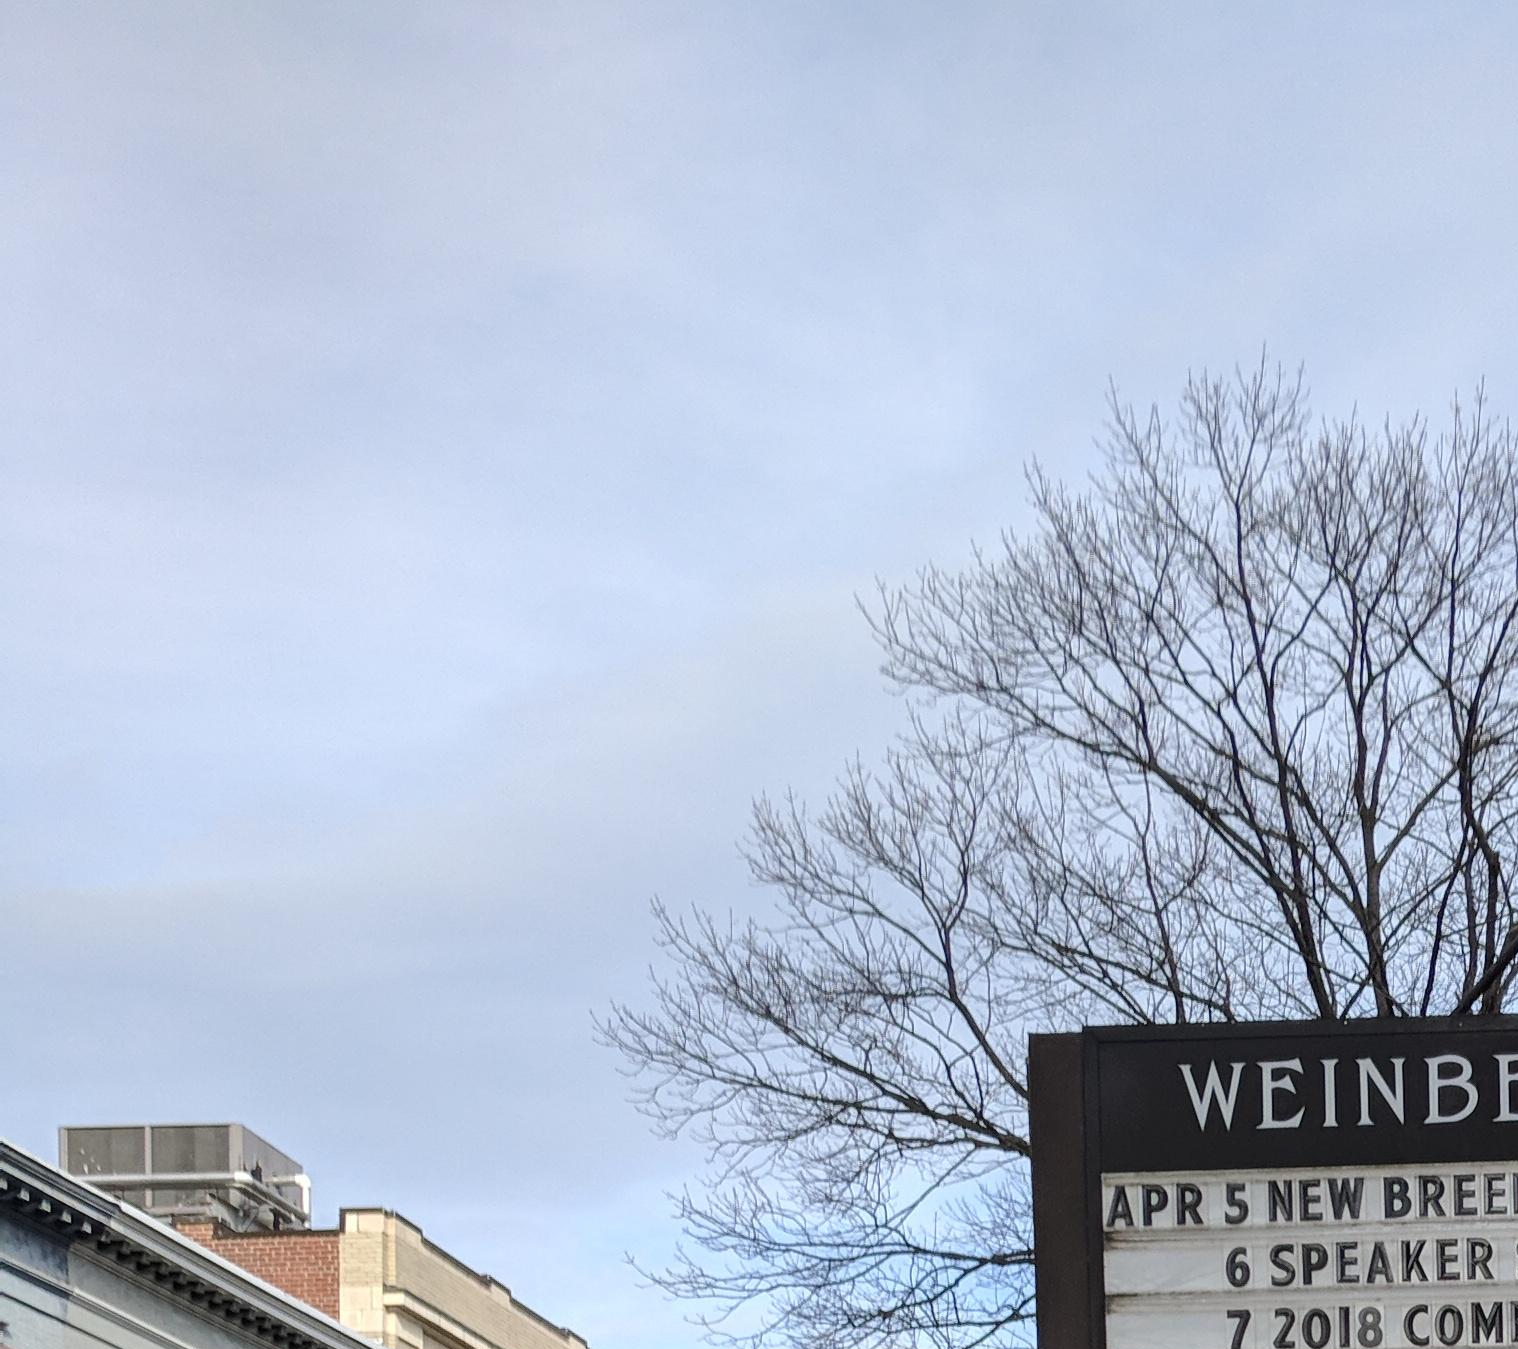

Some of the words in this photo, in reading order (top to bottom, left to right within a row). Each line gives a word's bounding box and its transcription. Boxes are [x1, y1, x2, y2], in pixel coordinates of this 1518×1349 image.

[1106, 1182, 1204, 1228] APR
[1224, 1182, 1248, 1224] 5
[1267, 1176, 1364, 1221] NEW
[1225, 1245, 1250, 1286] 6
[1269, 1236, 1493, 1286] SPEAKER
[1226, 1308, 1250, 1349] 7
[1272, 1305, 1383, 1349] 2018
